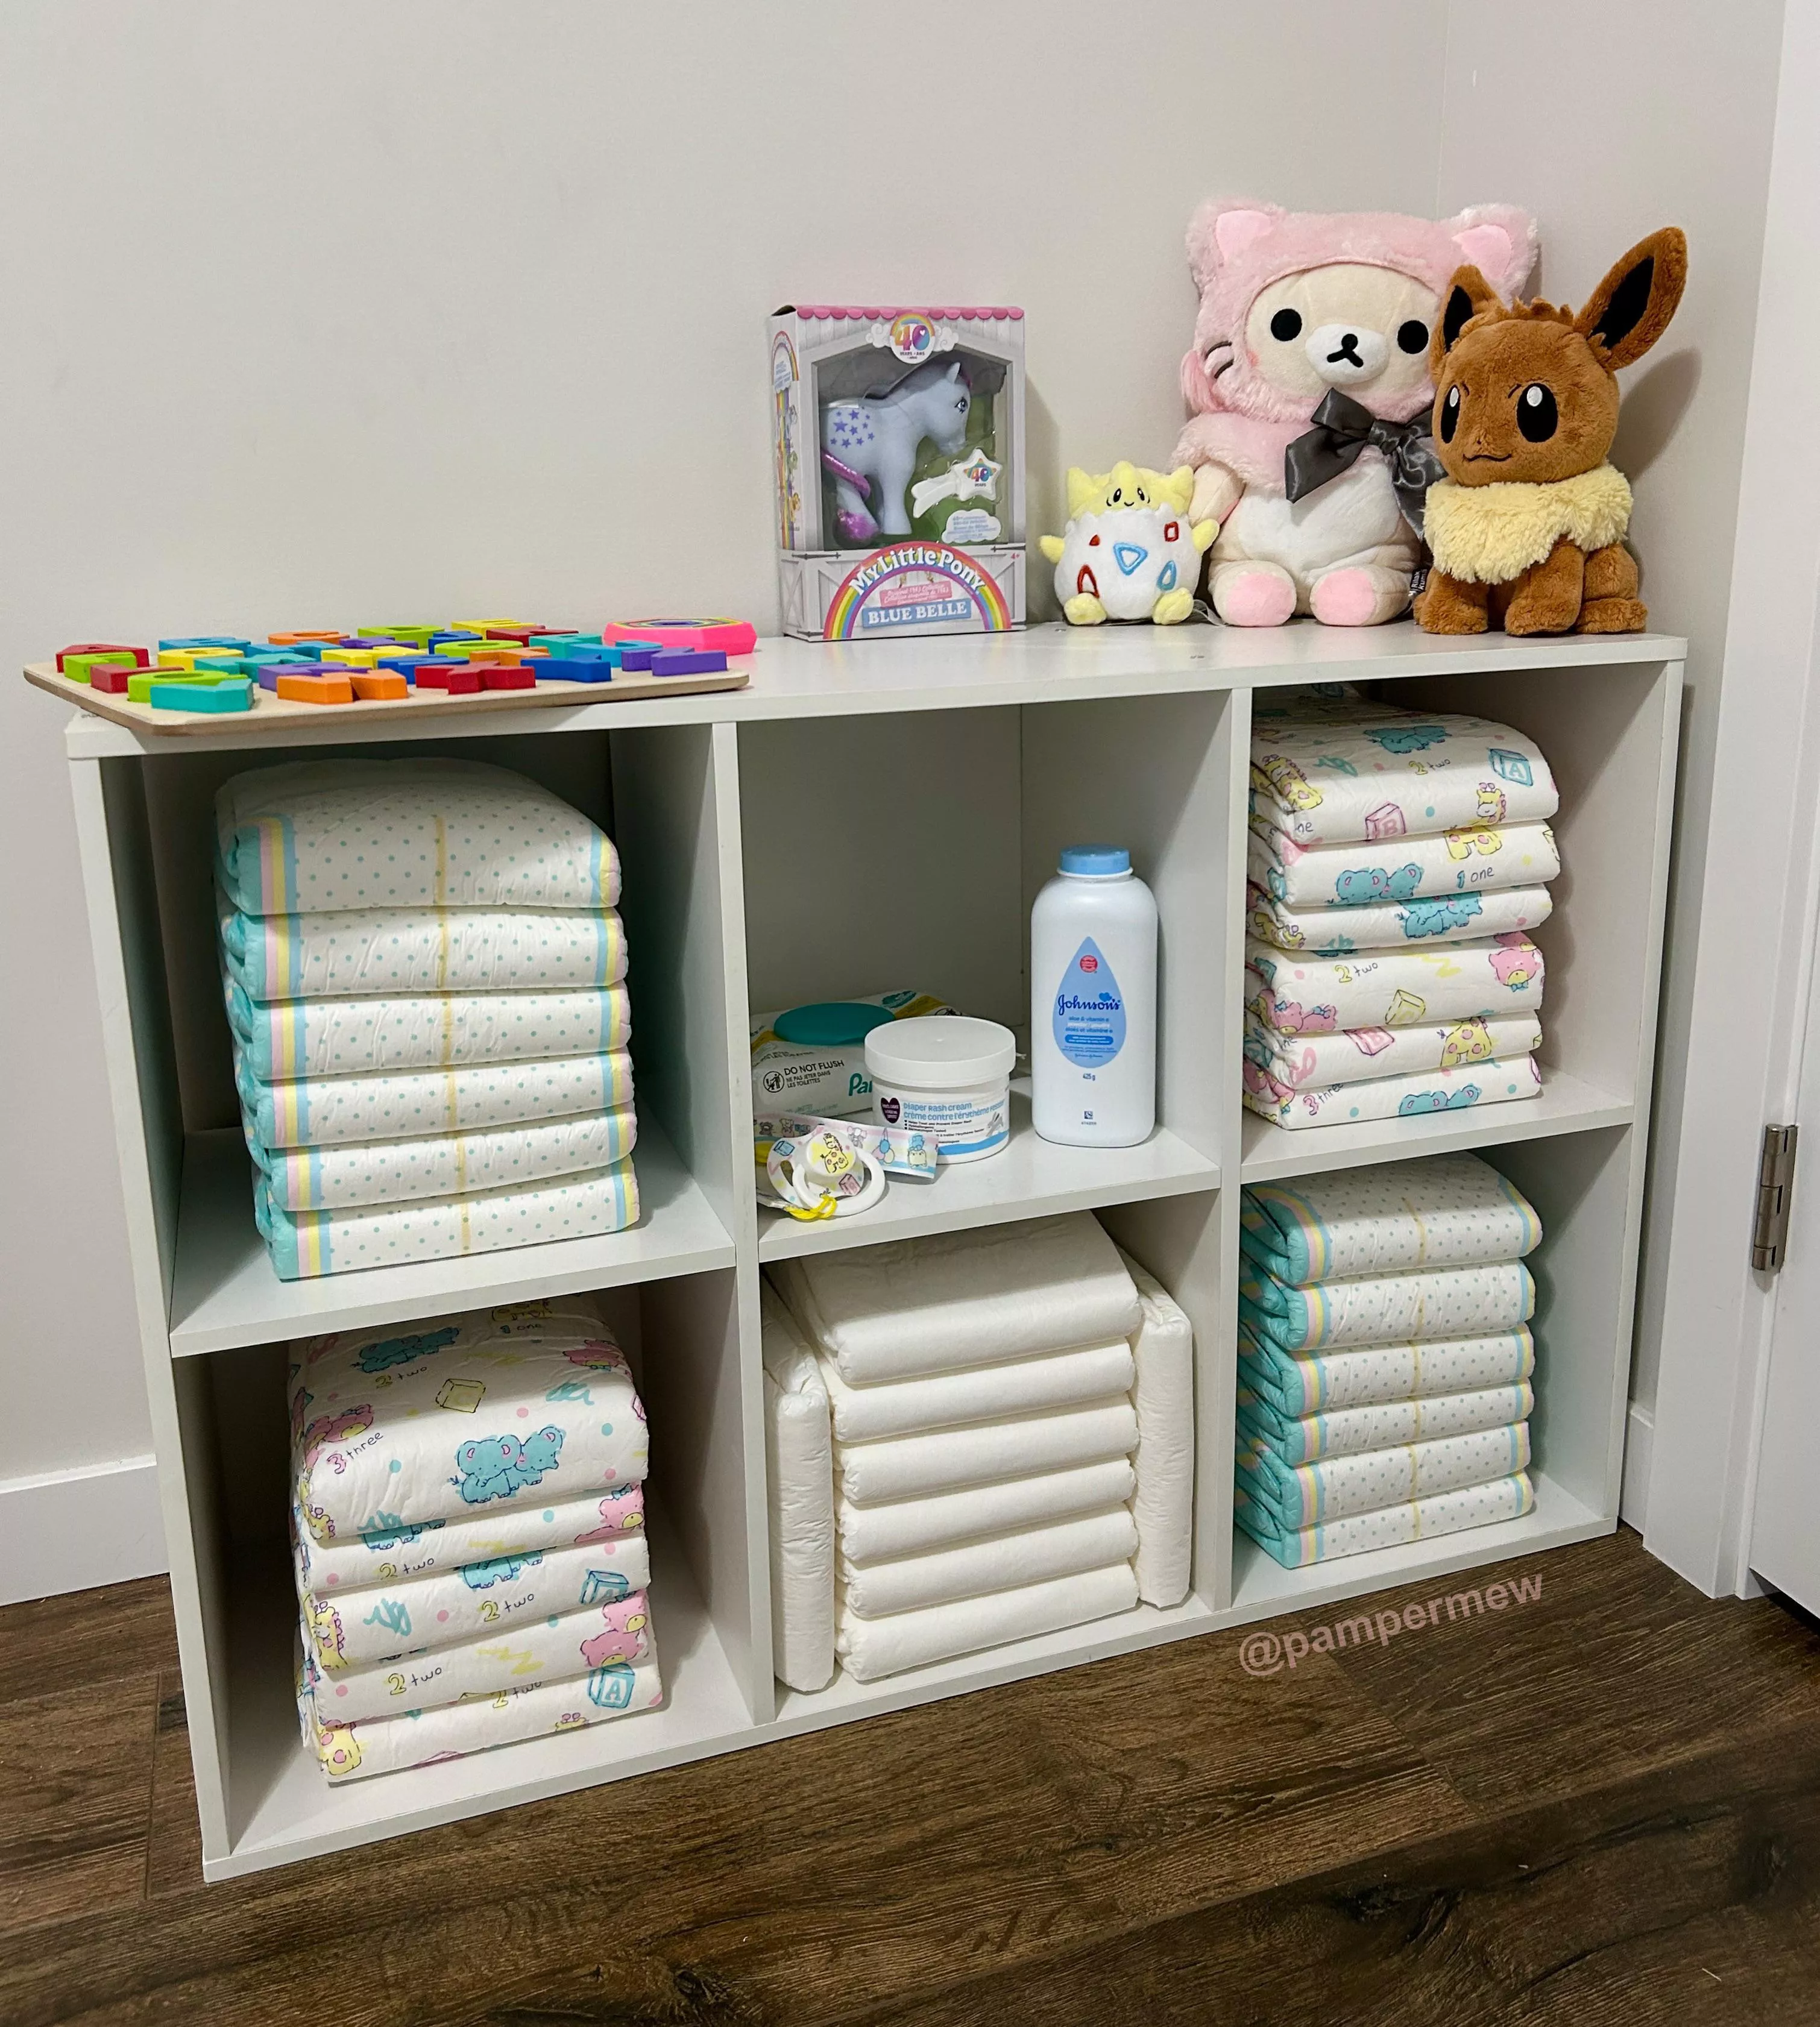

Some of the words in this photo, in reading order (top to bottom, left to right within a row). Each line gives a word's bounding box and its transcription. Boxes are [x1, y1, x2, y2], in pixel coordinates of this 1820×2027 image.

[895, 325, 930, 351] 40
[971, 468, 990, 482] 40
[877, 546, 936, 574] Little
[938, 549, 986, 591] Pony
[868, 608, 912, 624] BLUE
[916, 602, 967, 618] BELLE
[1409, 760, 1428, 775] 2
[1428, 758, 1452, 770] two
[1508, 762, 1523, 778] A
[1457, 870, 1465, 888] 1
[1471, 867, 1494, 882] one
[1335, 964, 1352, 983] 2
[1355, 962, 1378, 976] two
[1058, 994, 1119, 1016] Johnson's
[784, 1067, 798, 1075] DO
[799, 1064, 817, 1073] NOT
[818, 1060, 845, 1070] FLUSH
[796, 1078, 820, 1086] TOILETTES
[1303, 1095, 1319, 1116] 3
[1318, 1083, 1344, 1104] three
[397, 1366, 427, 1381] two
[327, 1453, 346, 1475] 3
[346, 1431, 383, 1460] three
[380, 1562, 398, 1580] 2
[403, 1558, 435, 1574] two
[482, 1600, 500, 1623] 2
[504, 1593, 534, 1613] two
[388, 1673, 407, 1695] 2
[411, 1667, 442, 1686] two
[605, 1679, 621, 1701] A
